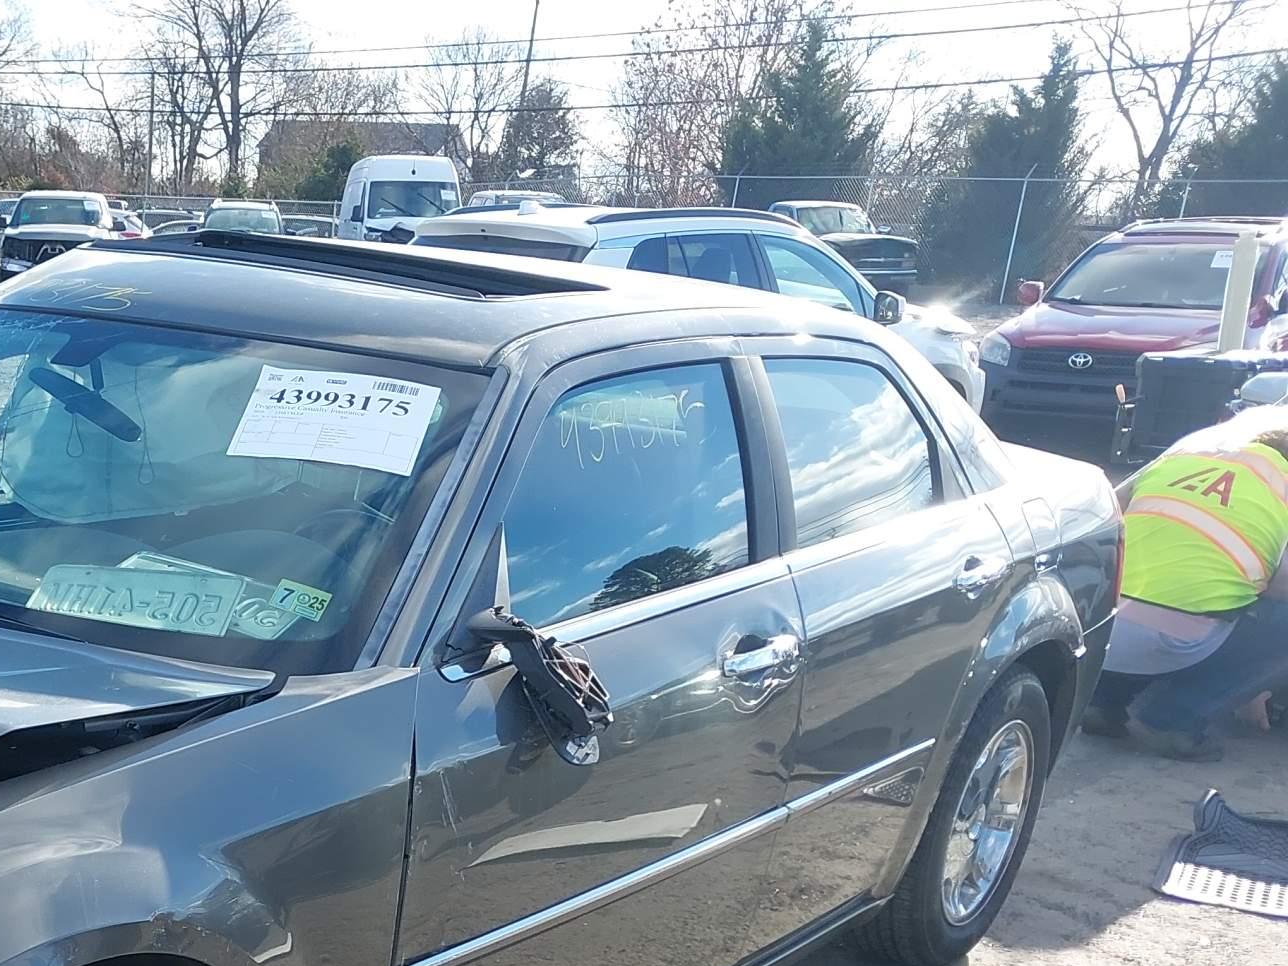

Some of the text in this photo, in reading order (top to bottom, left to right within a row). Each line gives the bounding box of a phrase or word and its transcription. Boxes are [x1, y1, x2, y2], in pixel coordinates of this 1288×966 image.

[269, 388, 412, 417] 43993175
[275, 587, 327, 611] 7 25
